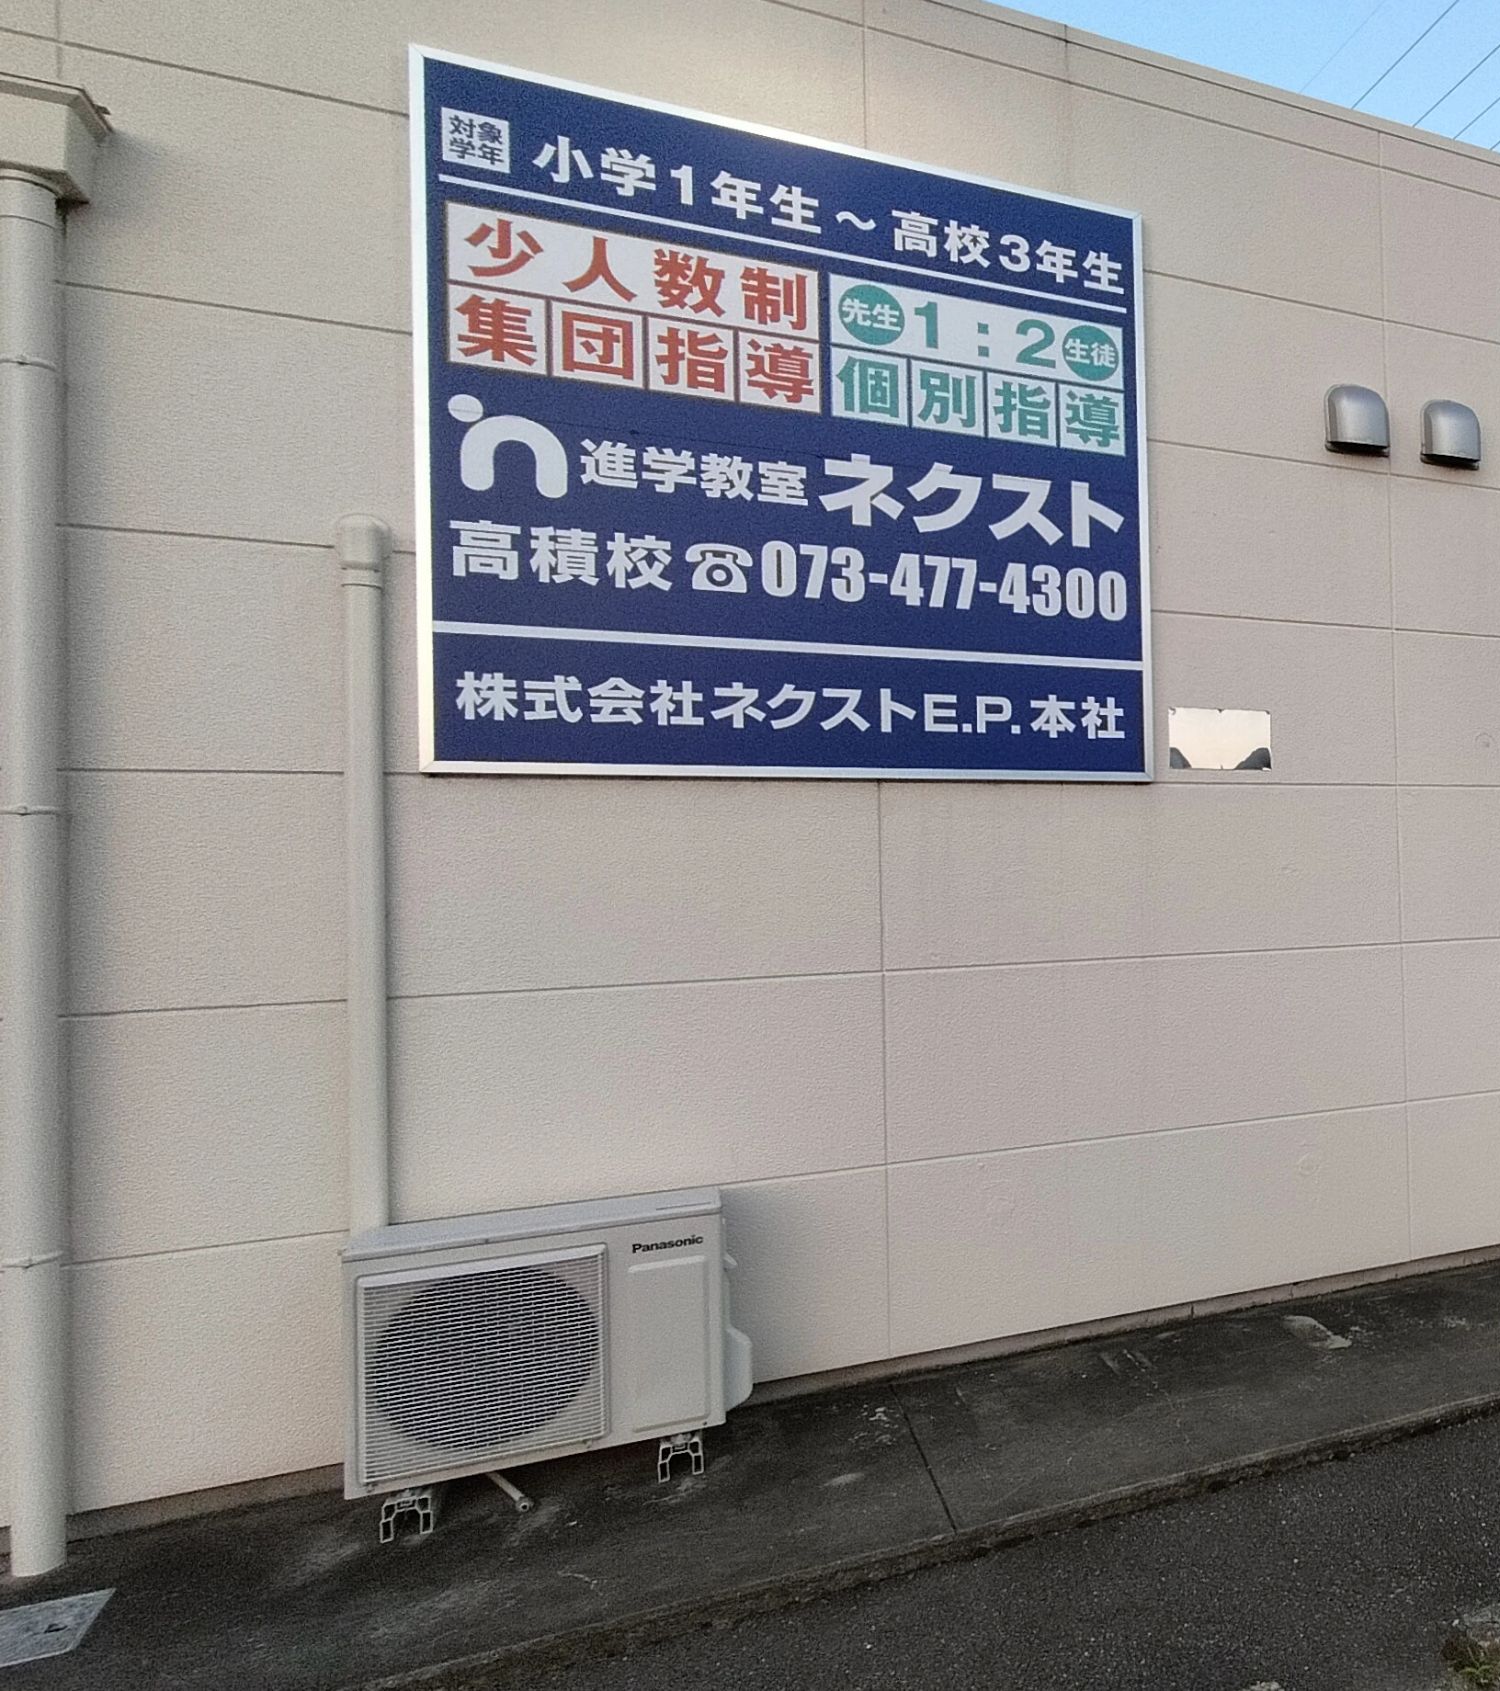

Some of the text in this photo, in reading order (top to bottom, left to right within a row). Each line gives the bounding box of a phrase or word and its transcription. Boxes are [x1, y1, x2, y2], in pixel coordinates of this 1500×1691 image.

[449, 114, 503, 143] 対象
[449, 136, 504, 166] 学年
[464, 218, 807, 331] 少人数制
[455, 294, 814, 403] 集団指導
[842, 297, 901, 332] 先生
[1064, 338, 1116, 369] 生徒
[836, 355, 1120, 448] 個別指導
[449, 520, 1128, 621] 高積校 073-477-4300
[631, 1234, 704, 1254] Panasonic
